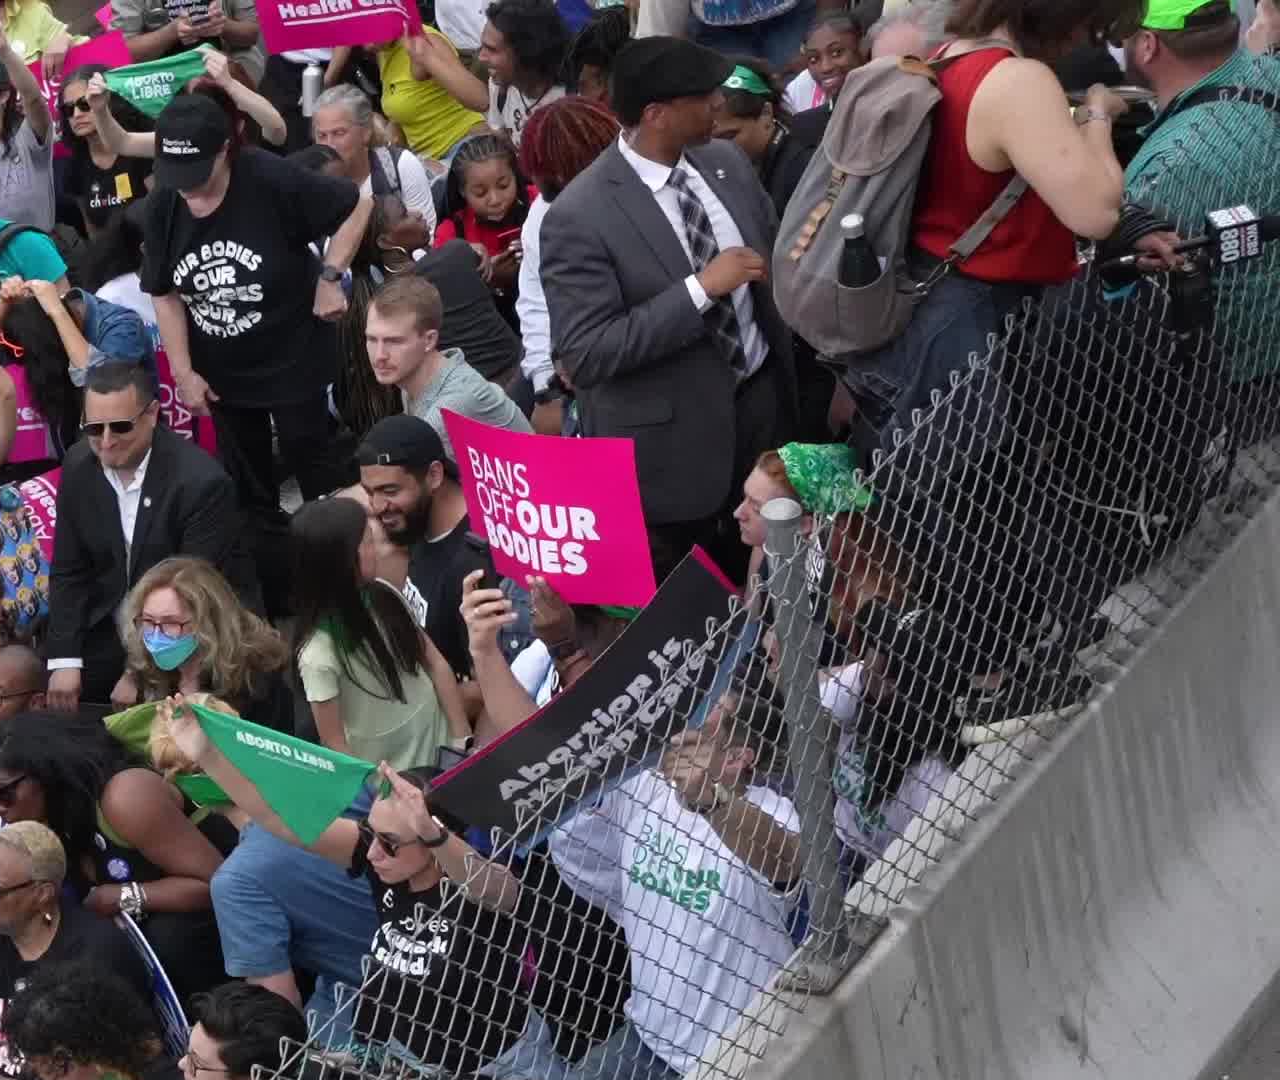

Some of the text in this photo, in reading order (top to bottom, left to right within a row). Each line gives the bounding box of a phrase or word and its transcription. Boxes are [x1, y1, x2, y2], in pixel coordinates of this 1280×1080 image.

[125, 71, 175, 91] ABORTO
[131, 84, 172, 99] LIBRE
[173, 240, 263, 286] OUR BODIES
[1220, 228, 1240, 263] 880
[193, 265, 236, 291] OUR
[467, 446, 530, 498] BANS
[476, 481, 601, 541] OFF OUR
[483, 515, 588, 576] BODIES
[235, 731, 292, 757] ABORTO
[293, 748, 337, 773] LIBRE
[498, 673, 653, 800] Abortion
